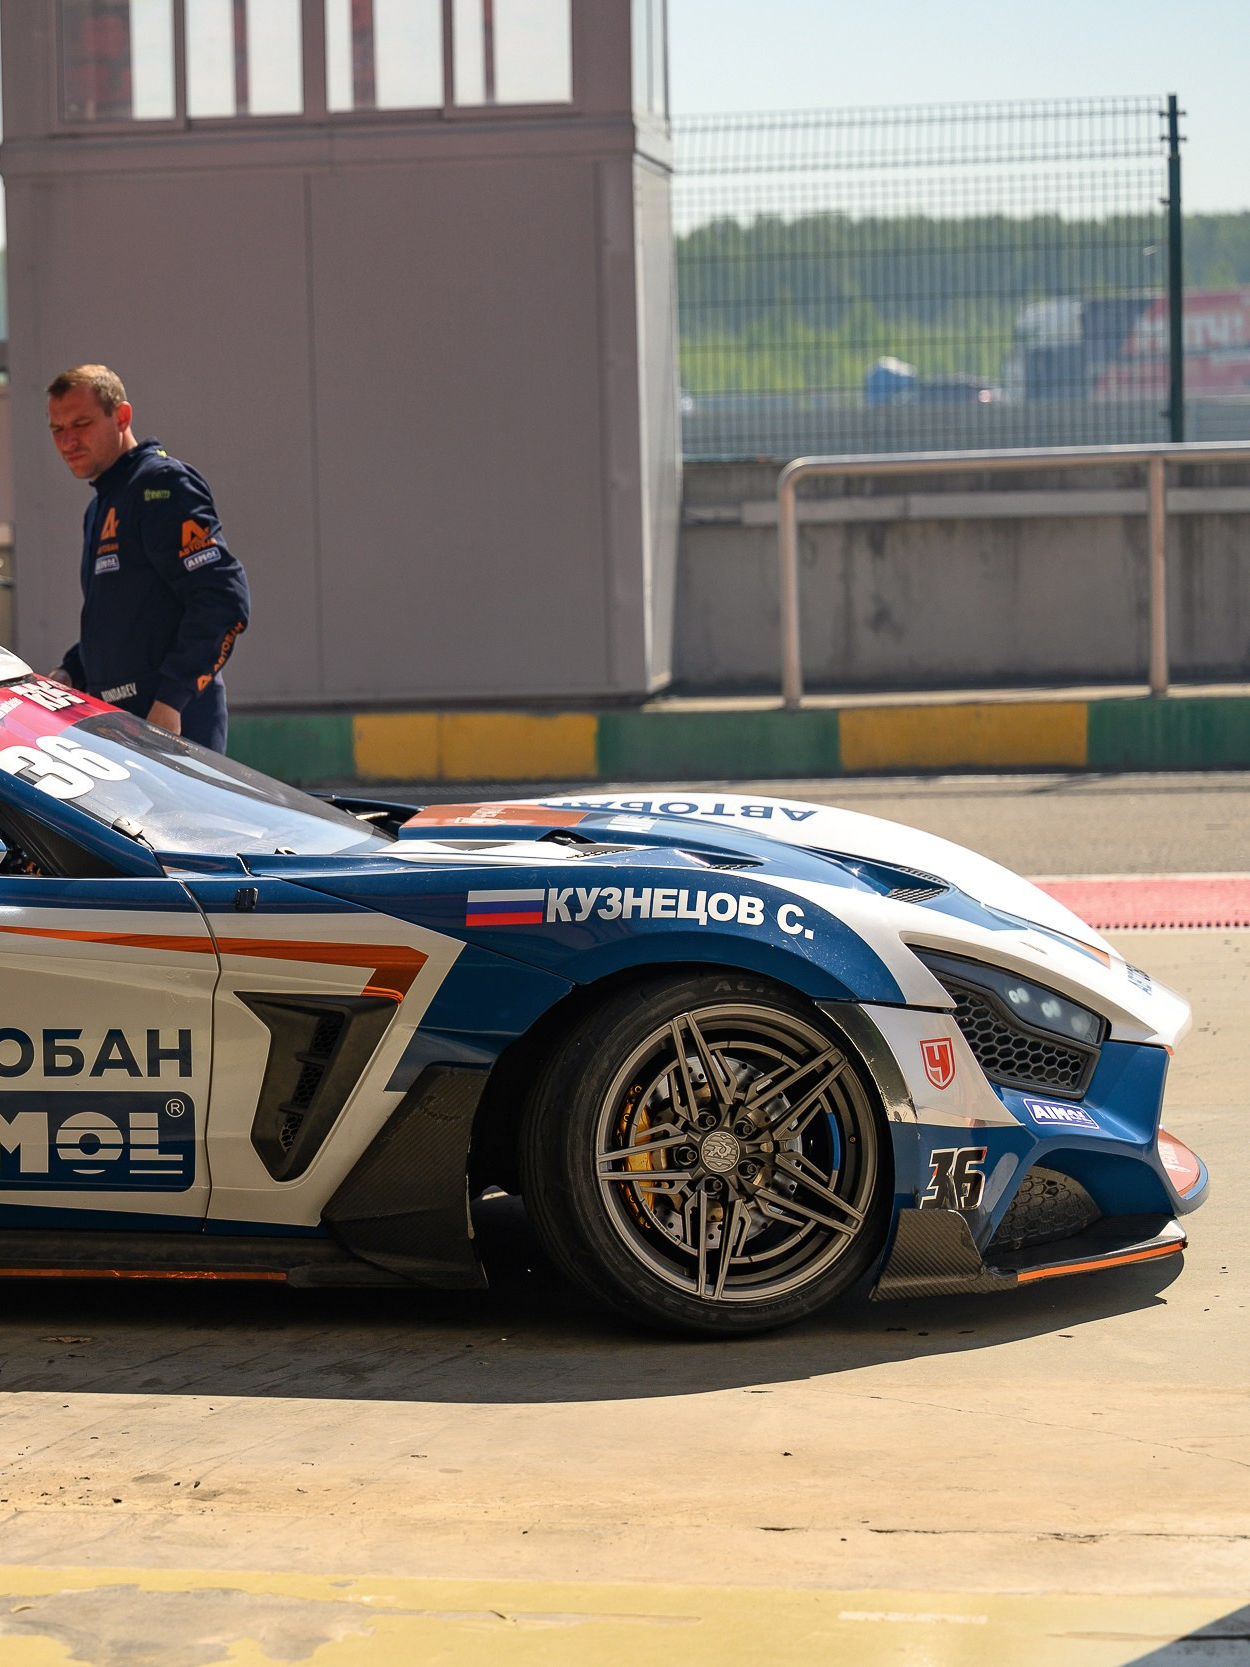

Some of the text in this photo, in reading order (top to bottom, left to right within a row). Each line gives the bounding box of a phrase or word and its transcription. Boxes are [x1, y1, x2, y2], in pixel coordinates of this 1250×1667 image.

[547, 887, 814, 940] КУЗНЕЦОВ С.
[1033, 1104, 1092, 1124] AIMOL
